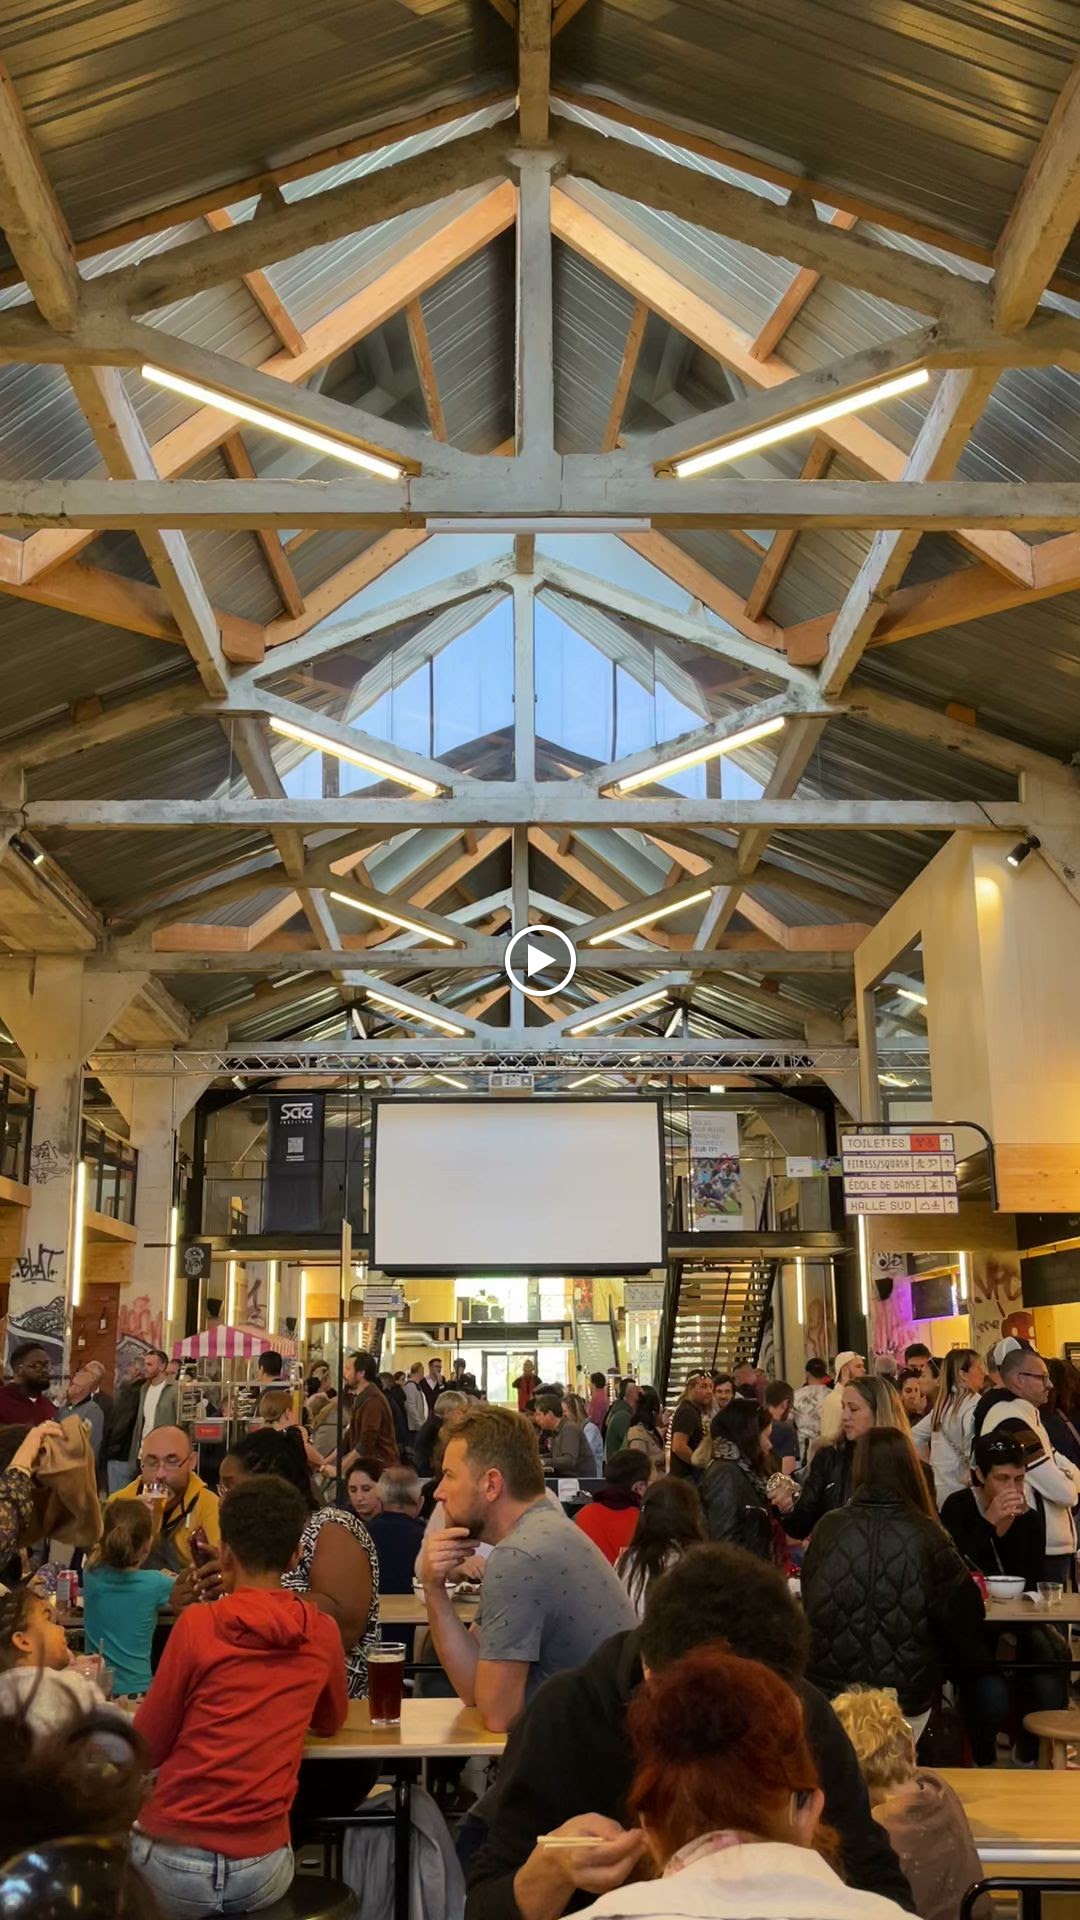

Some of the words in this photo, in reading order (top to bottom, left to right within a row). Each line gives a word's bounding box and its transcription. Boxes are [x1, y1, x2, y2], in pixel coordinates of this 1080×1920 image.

[848, 1138, 905, 1149] TOILETTES
[847, 1159, 910, 1170] FITNESS/SQUASH
[848, 1178, 877, 1191] ÉCOLE
[880, 1180, 891, 1190] DE
[894, 1180, 921, 1190] DANSE
[851, 1201, 887, 1211] HALLE
[890, 1201, 912, 1211] SUD
